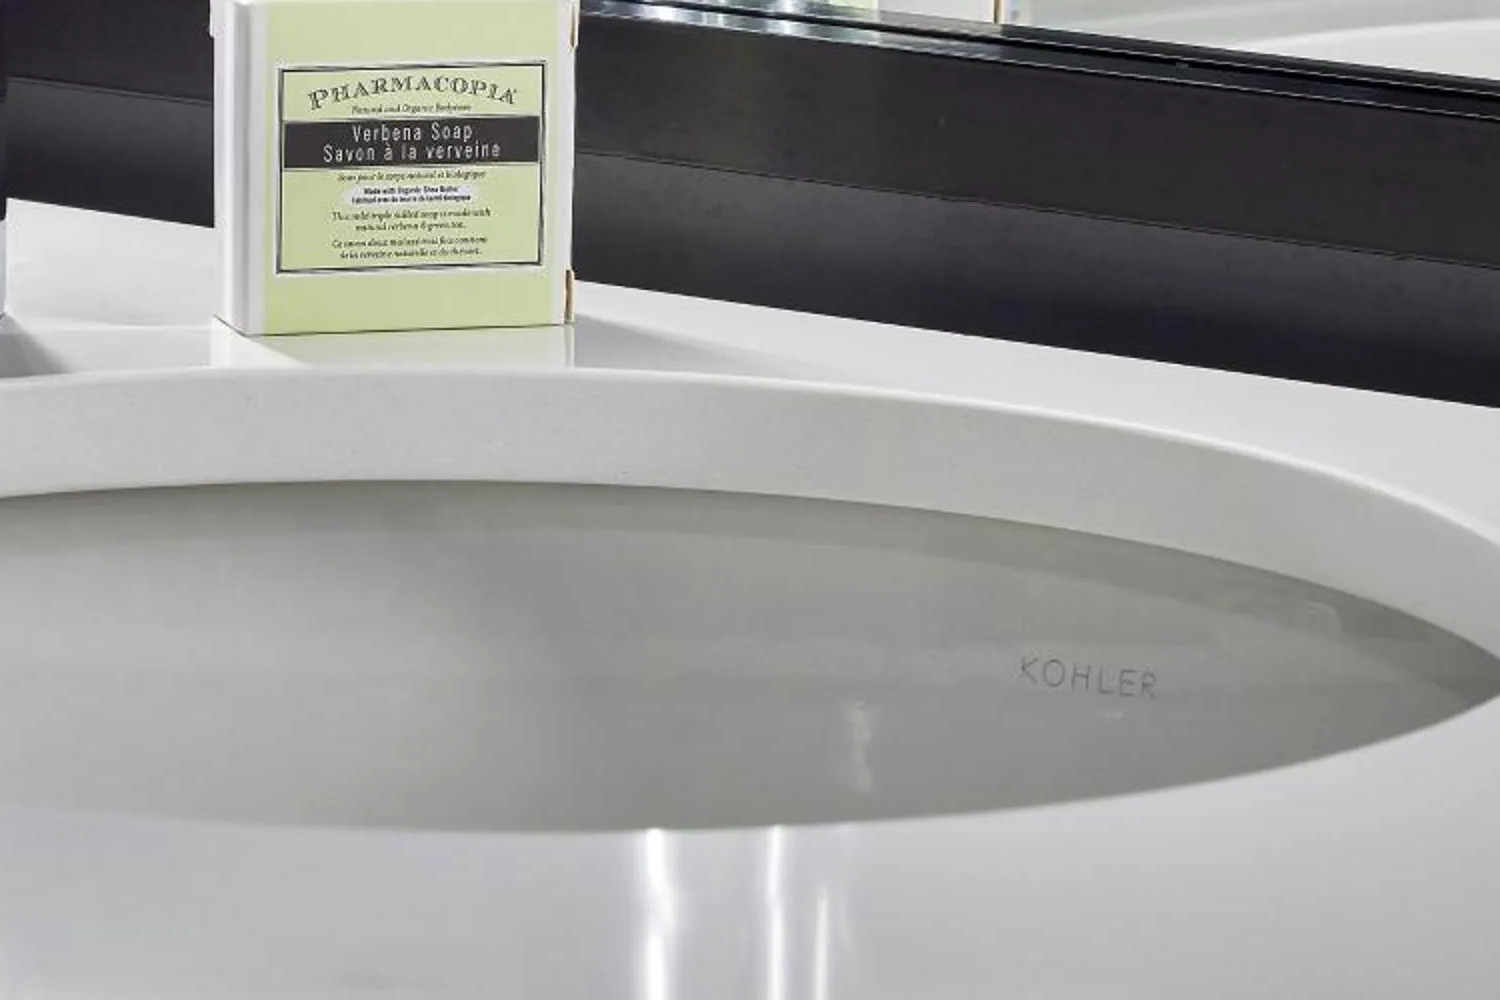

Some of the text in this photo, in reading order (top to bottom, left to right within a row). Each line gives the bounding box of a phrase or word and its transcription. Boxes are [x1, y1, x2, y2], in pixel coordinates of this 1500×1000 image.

[307, 75, 515, 111] PHARMACOPIA
[385, 105, 401, 113] and
[402, 103, 433, 115] Organic
[352, 121, 473, 143] Verbena Soap
[323, 140, 501, 163] Savon à la verveine
[1021, 657, 1157, 698] KOHLER
